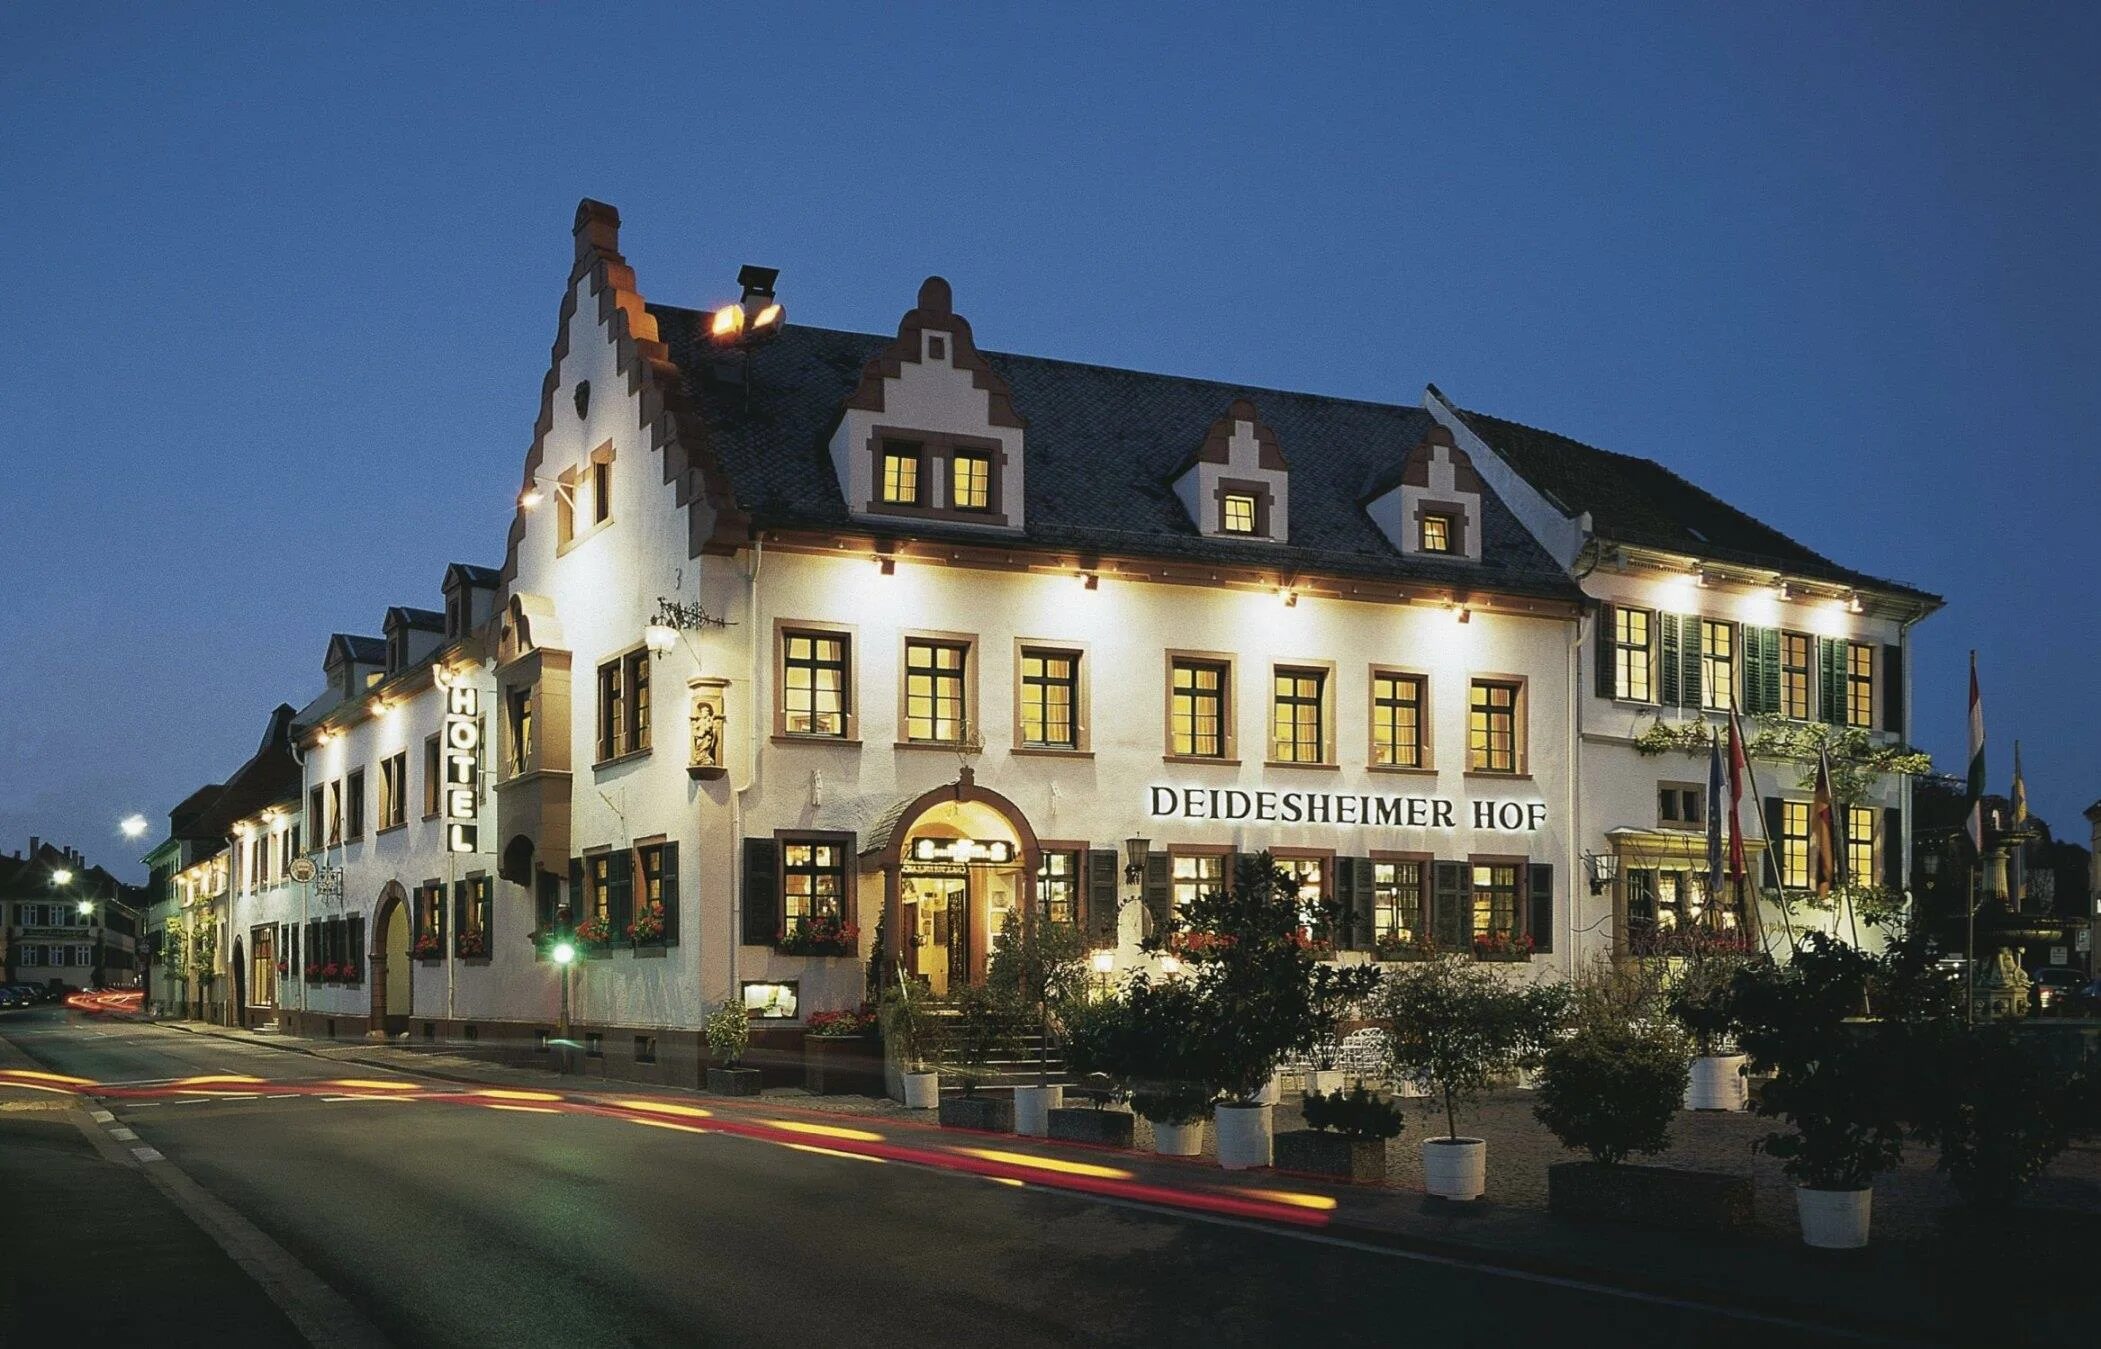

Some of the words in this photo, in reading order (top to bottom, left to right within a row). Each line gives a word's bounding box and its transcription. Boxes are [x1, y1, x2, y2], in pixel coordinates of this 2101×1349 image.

[450, 687, 477, 853] HOTEL
[1150, 785, 1456, 828] DEIDESHEIMER
[1473, 800, 1547, 831] HOF
